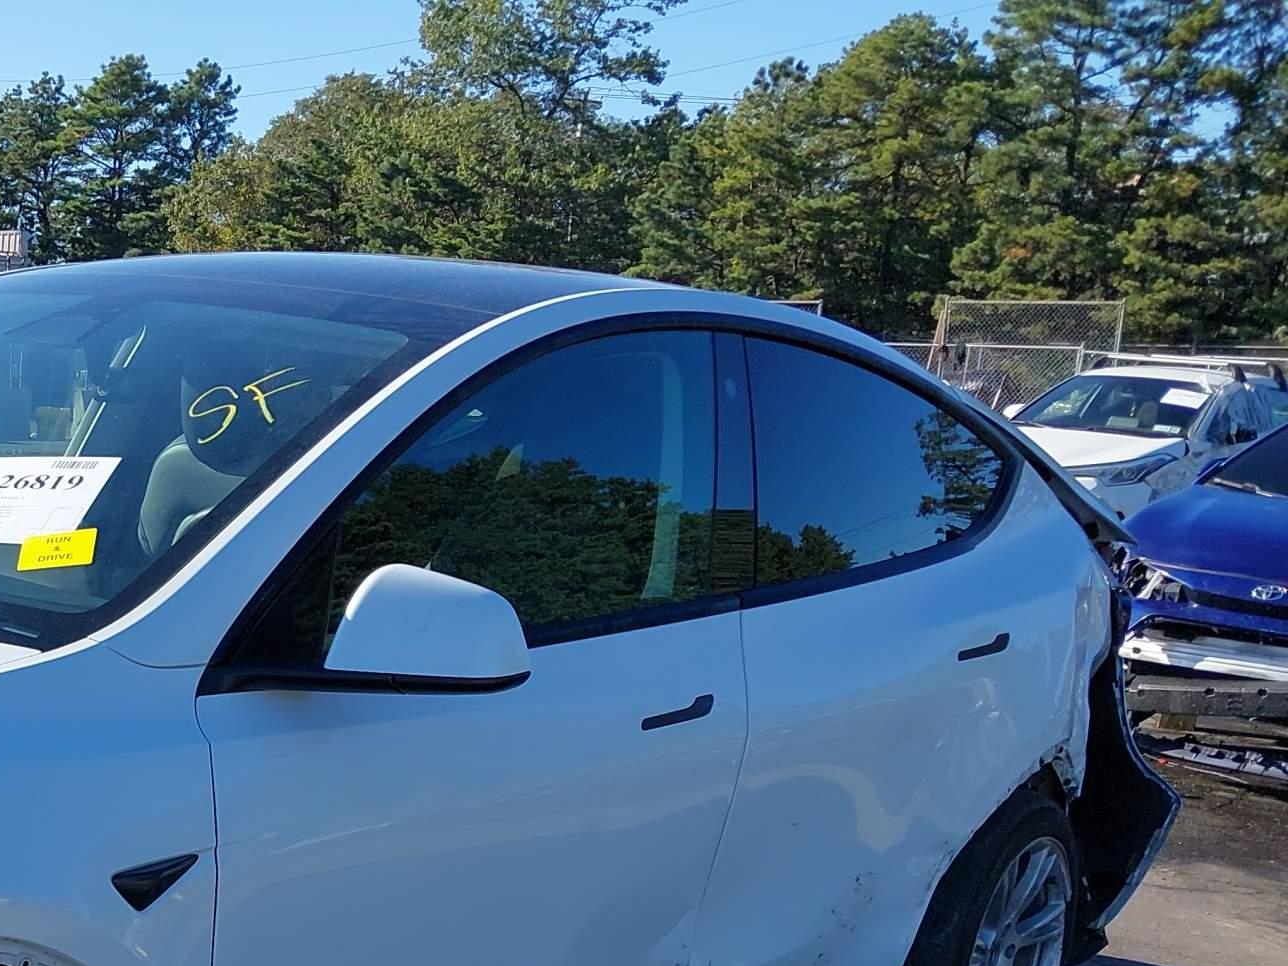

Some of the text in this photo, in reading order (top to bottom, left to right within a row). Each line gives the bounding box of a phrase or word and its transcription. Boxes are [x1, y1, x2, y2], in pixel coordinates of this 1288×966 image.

[188, 366, 312, 444] SF
[46, 536, 72, 544] RUN
[37, 553, 73, 562] DRIVE
